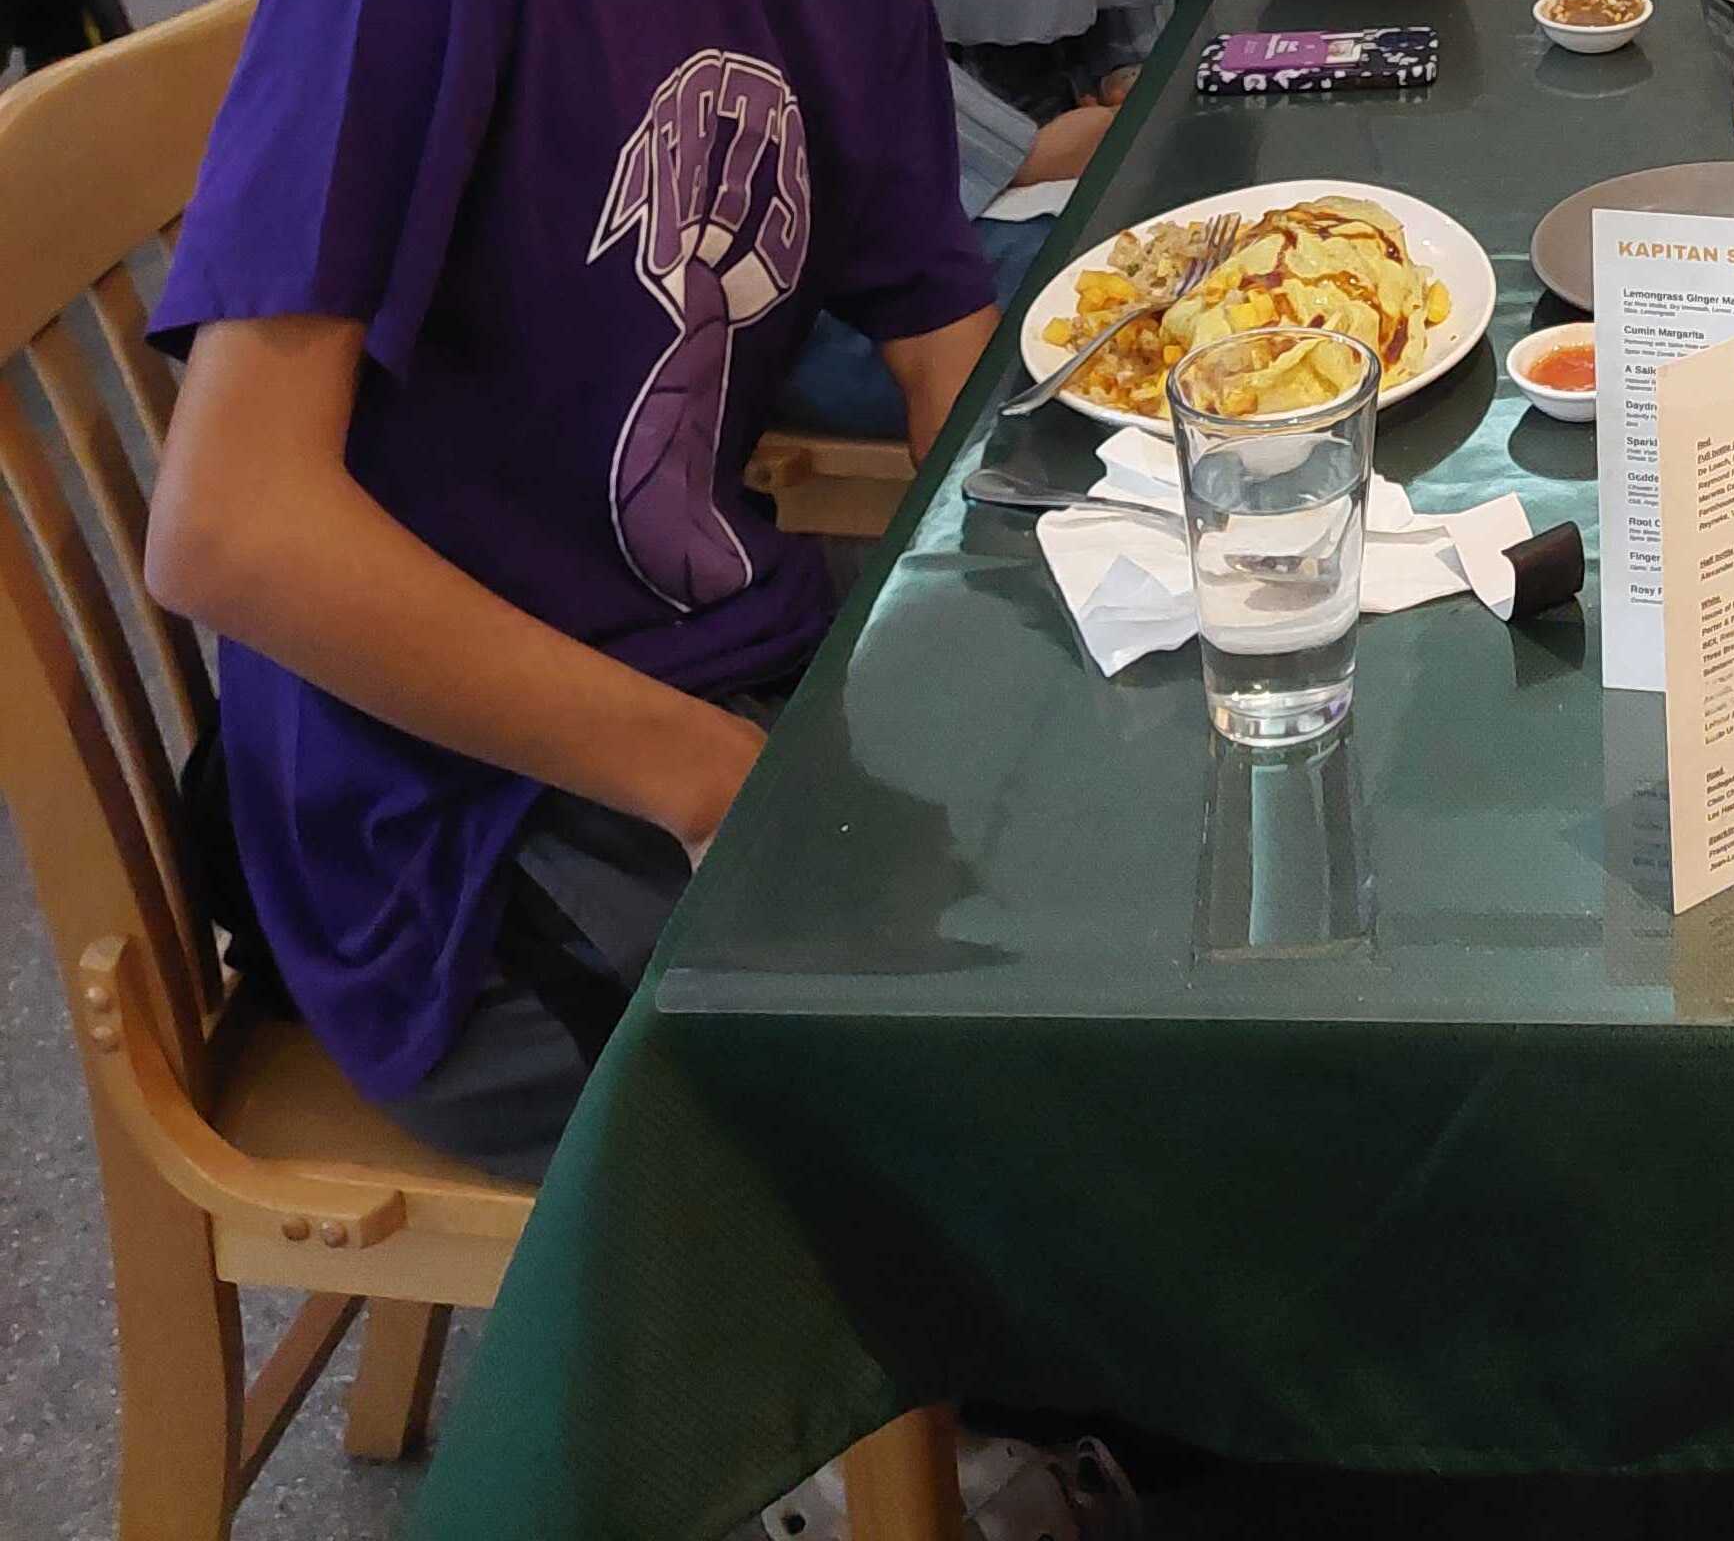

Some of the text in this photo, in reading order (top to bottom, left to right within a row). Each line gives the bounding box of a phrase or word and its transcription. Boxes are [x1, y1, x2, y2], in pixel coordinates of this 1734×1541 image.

[1618, 241, 1718, 262] KAPITAN
[1623, 288, 1684, 302] Lemongrass
[1686, 293, 1719, 305] Ginger
[1623, 325, 1705, 340] Cumin Margarita
[1625, 365, 1632, 373] A
[1629, 517, 1652, 527] Root
[1630, 551, 1661, 563] Finger
[1631, 584, 1655, 597] Rosy
